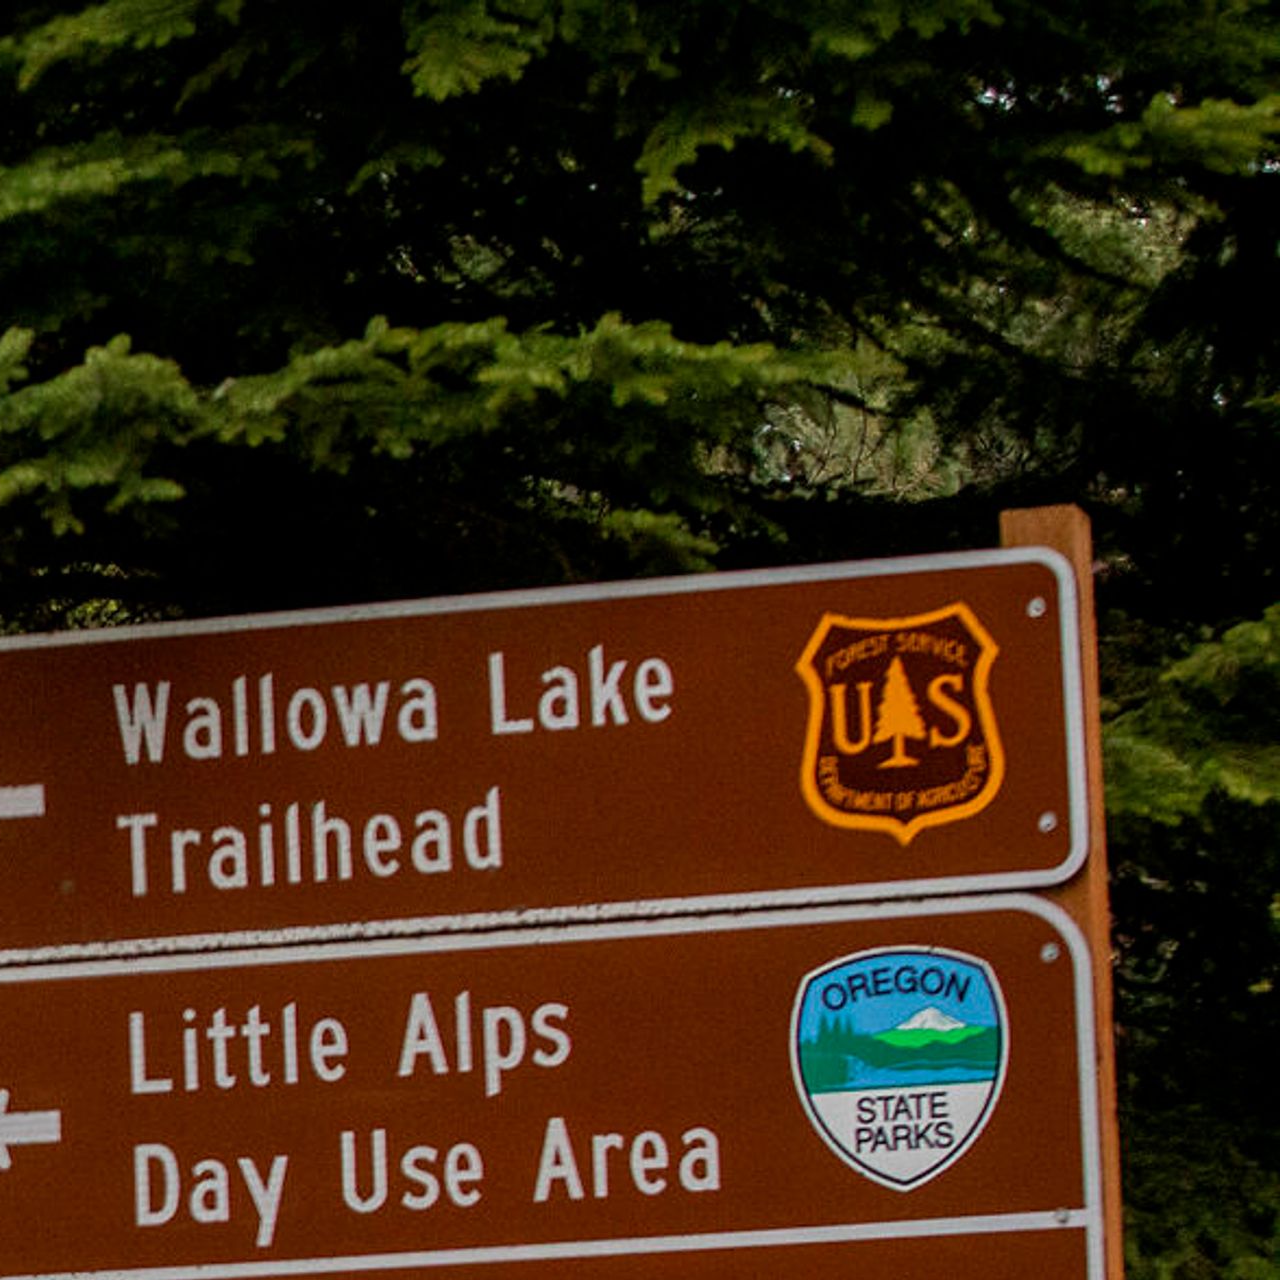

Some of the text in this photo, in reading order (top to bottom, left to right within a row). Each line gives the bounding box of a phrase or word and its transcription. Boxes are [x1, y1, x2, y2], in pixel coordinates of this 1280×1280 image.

[114, 645, 673, 764] Wallowa Lake
[117, 785, 502, 895] Trailhead
[821, 965, 971, 1011] OREGON
[129, 991, 571, 1097] Little Alps
[855, 1121, 955, 1154] PARKS
[856, 1091, 949, 1124] STATE
[134, 1117, 720, 1247] Day Use Area
